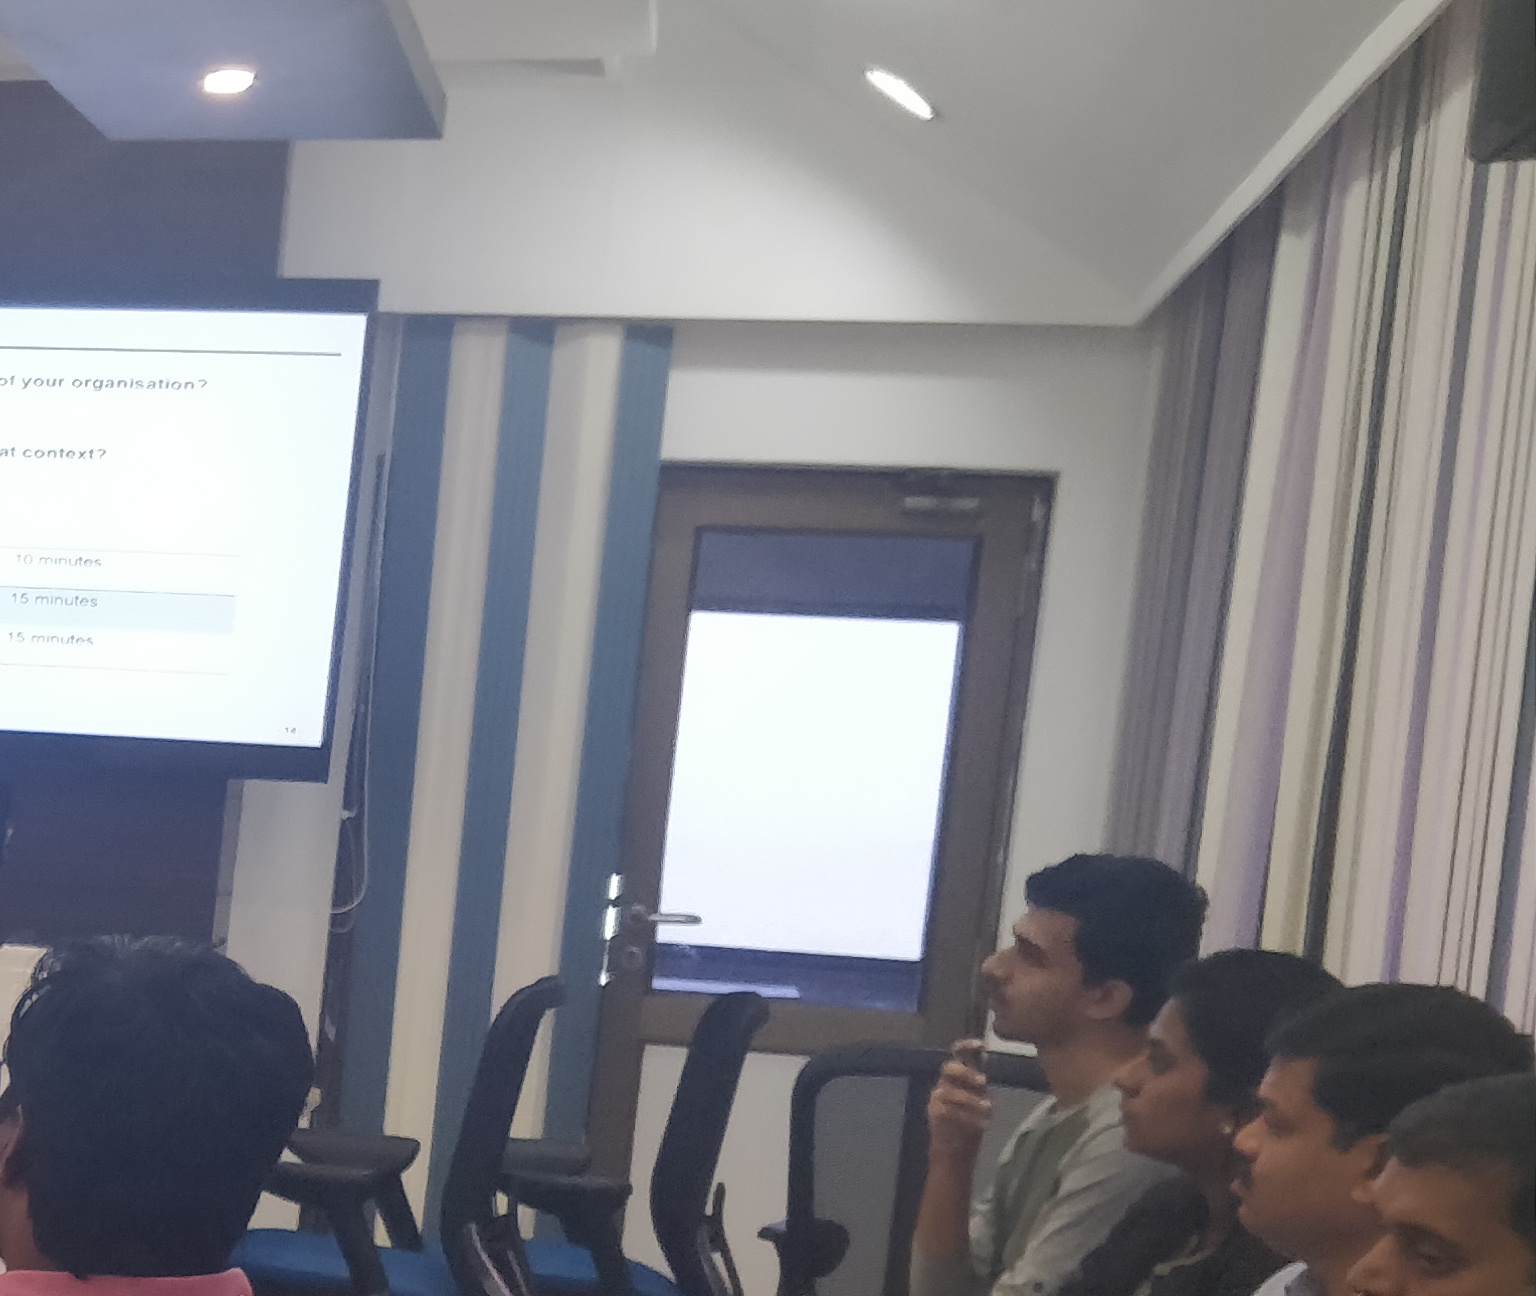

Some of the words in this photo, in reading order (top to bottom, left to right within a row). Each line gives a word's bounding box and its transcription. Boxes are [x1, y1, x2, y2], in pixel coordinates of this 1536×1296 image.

[21, 377, 65, 389] your
[71, 377, 208, 391] organisation?
[22, 448, 107, 461] context?
[16, 553, 34, 565] 10
[39, 556, 102, 567] minutes
[11, 592, 29, 605] 15
[34, 594, 98, 608] minutes
[8, 631, 25, 643] 15
[31, 634, 94, 646] minutes
